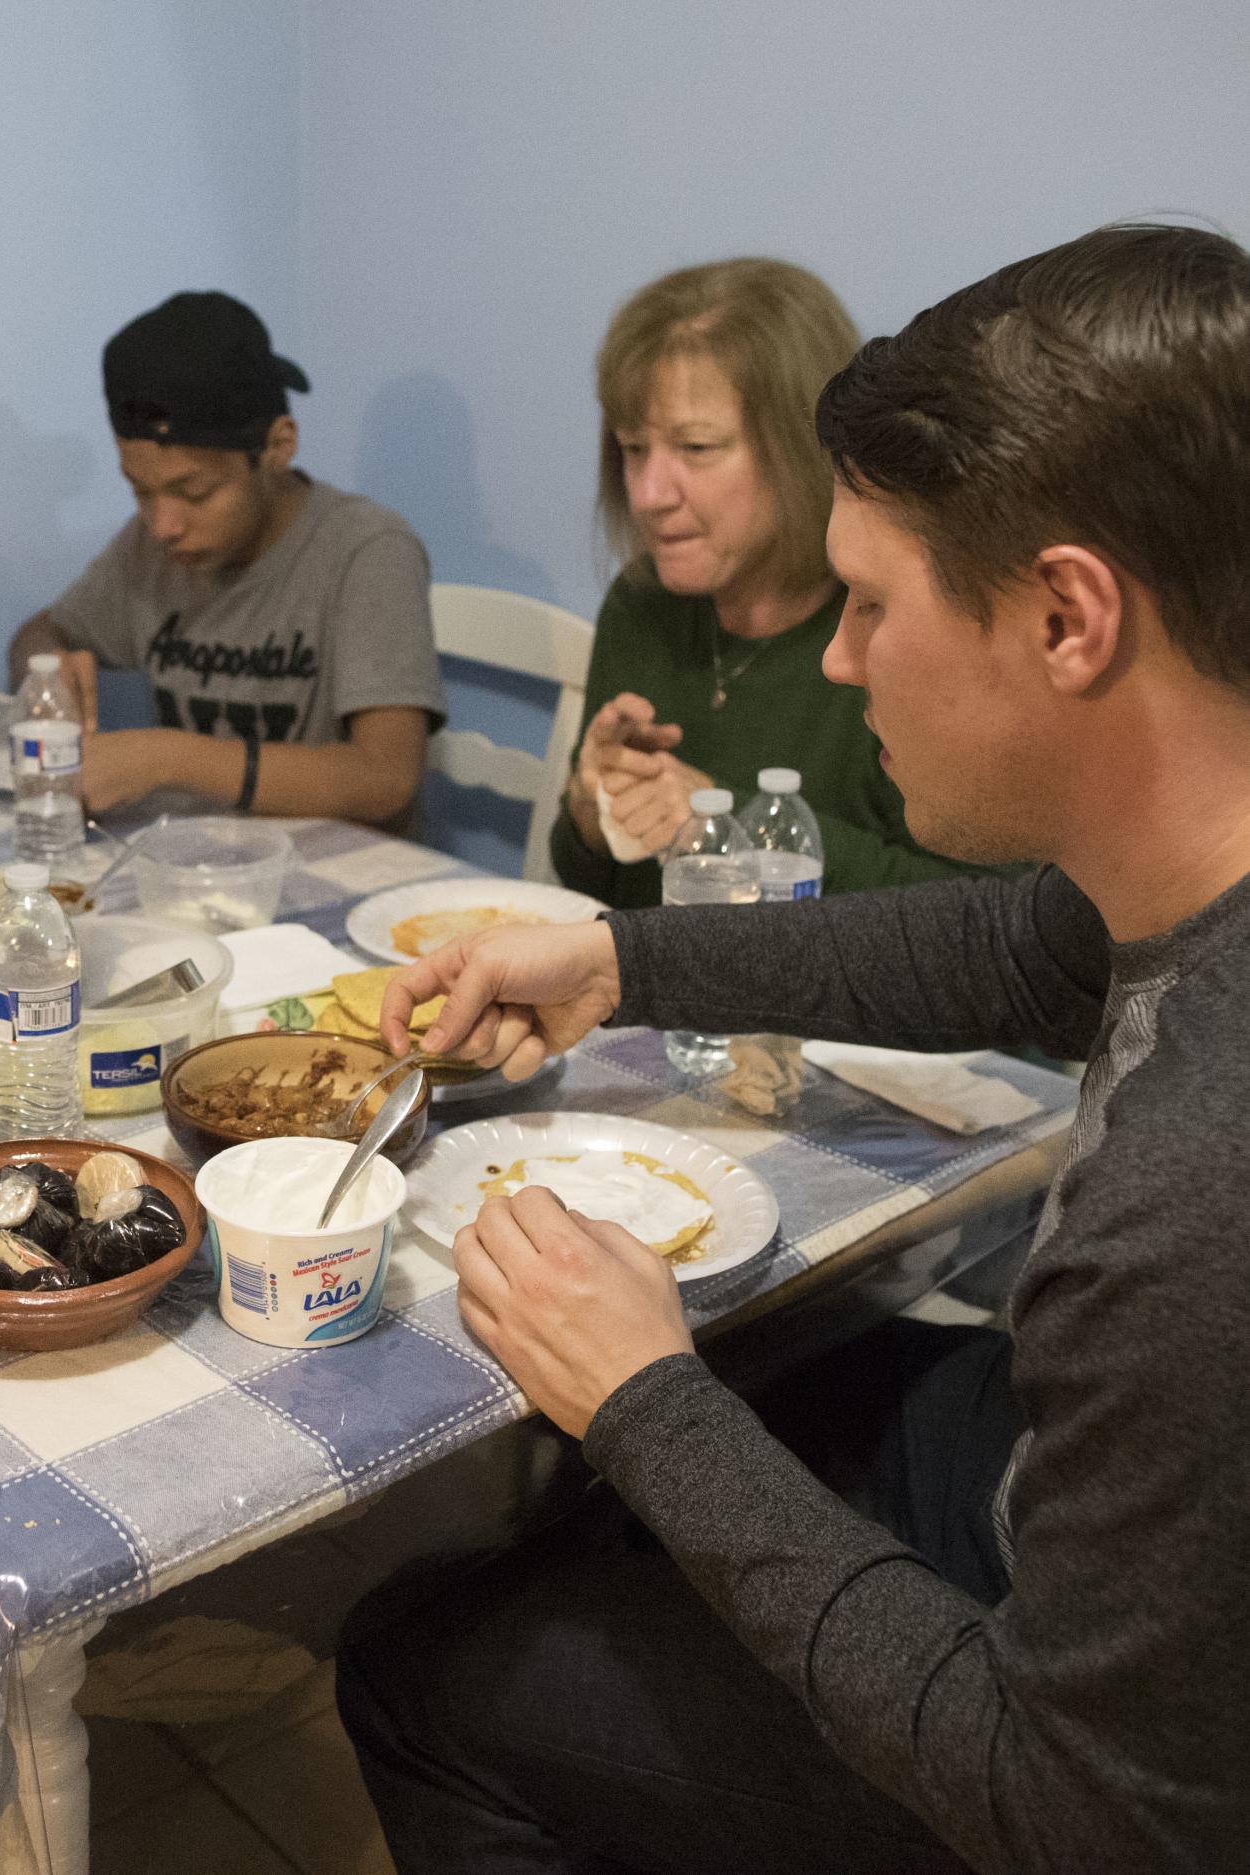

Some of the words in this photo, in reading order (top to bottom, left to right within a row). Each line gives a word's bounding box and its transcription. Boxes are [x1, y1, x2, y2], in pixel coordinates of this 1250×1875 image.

[292, 1264, 320, 1277] Mexican
[320, 1259, 337, 1269] Style
[338, 1254, 352, 1264] Sour
[297, 1258, 313, 1268] Rich
[313, 1254, 328, 1264] and
[328, 1247, 354, 1259] Creamy
[304, 1280, 361, 1311] LALA
